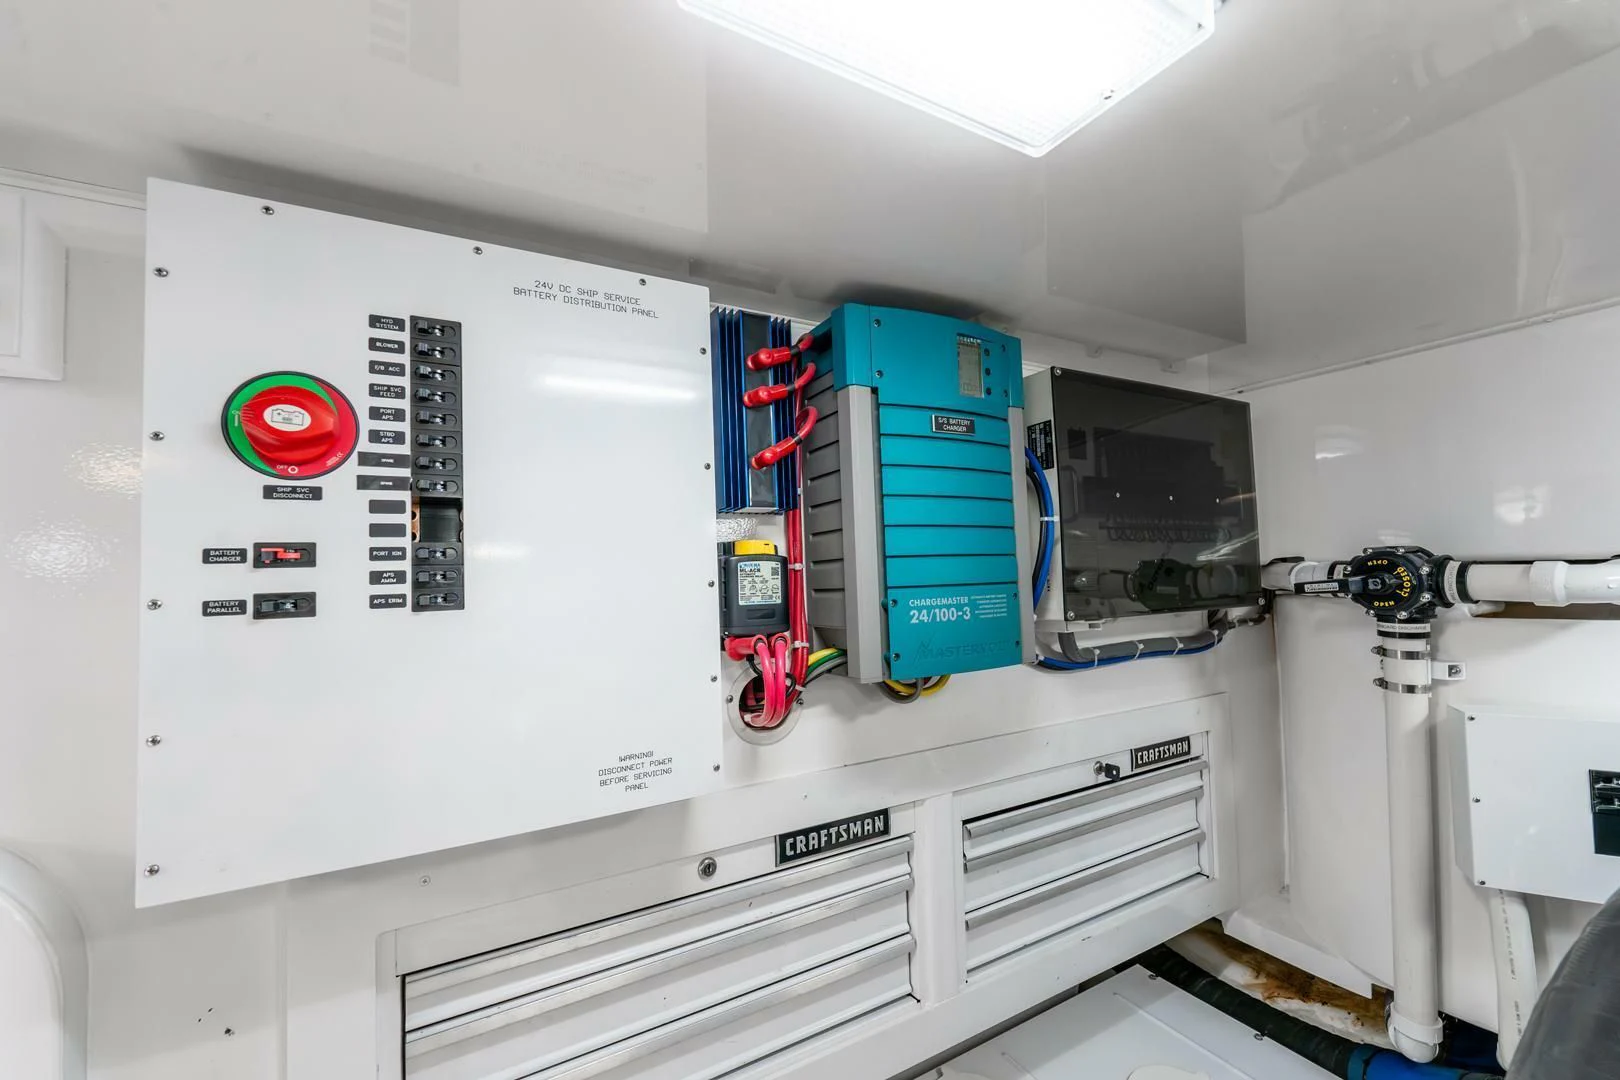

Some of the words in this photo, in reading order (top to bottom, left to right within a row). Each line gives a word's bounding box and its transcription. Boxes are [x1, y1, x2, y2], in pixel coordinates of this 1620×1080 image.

[513, 286, 558, 301] BATTERY
[564, 296, 627, 313] DISTRIBUTION
[632, 307, 659, 318] PANEL
[534, 280, 554, 290] 24V
[559, 284, 572, 294] DC
[577, 288, 598, 298] SHIP
[604, 292, 641, 306] SERVICE
[949, 418, 971, 426] BATTERY
[1397, 566, 1411, 597] CLOSED
[909, 596, 969, 607] CHARGEMASTER
[910, 606, 971, 624] 24/100-3
[1136, 740, 1189, 765] CRAFTSMAN
[598, 762, 645, 777] DISCONNECT
[650, 757, 673, 767] POWER
[599, 775, 629, 787] BEFORE
[634, 767, 673, 780] SERVICING
[625, 782, 649, 792] PANEL
[784, 816, 885, 857] CRAFTSMAN
